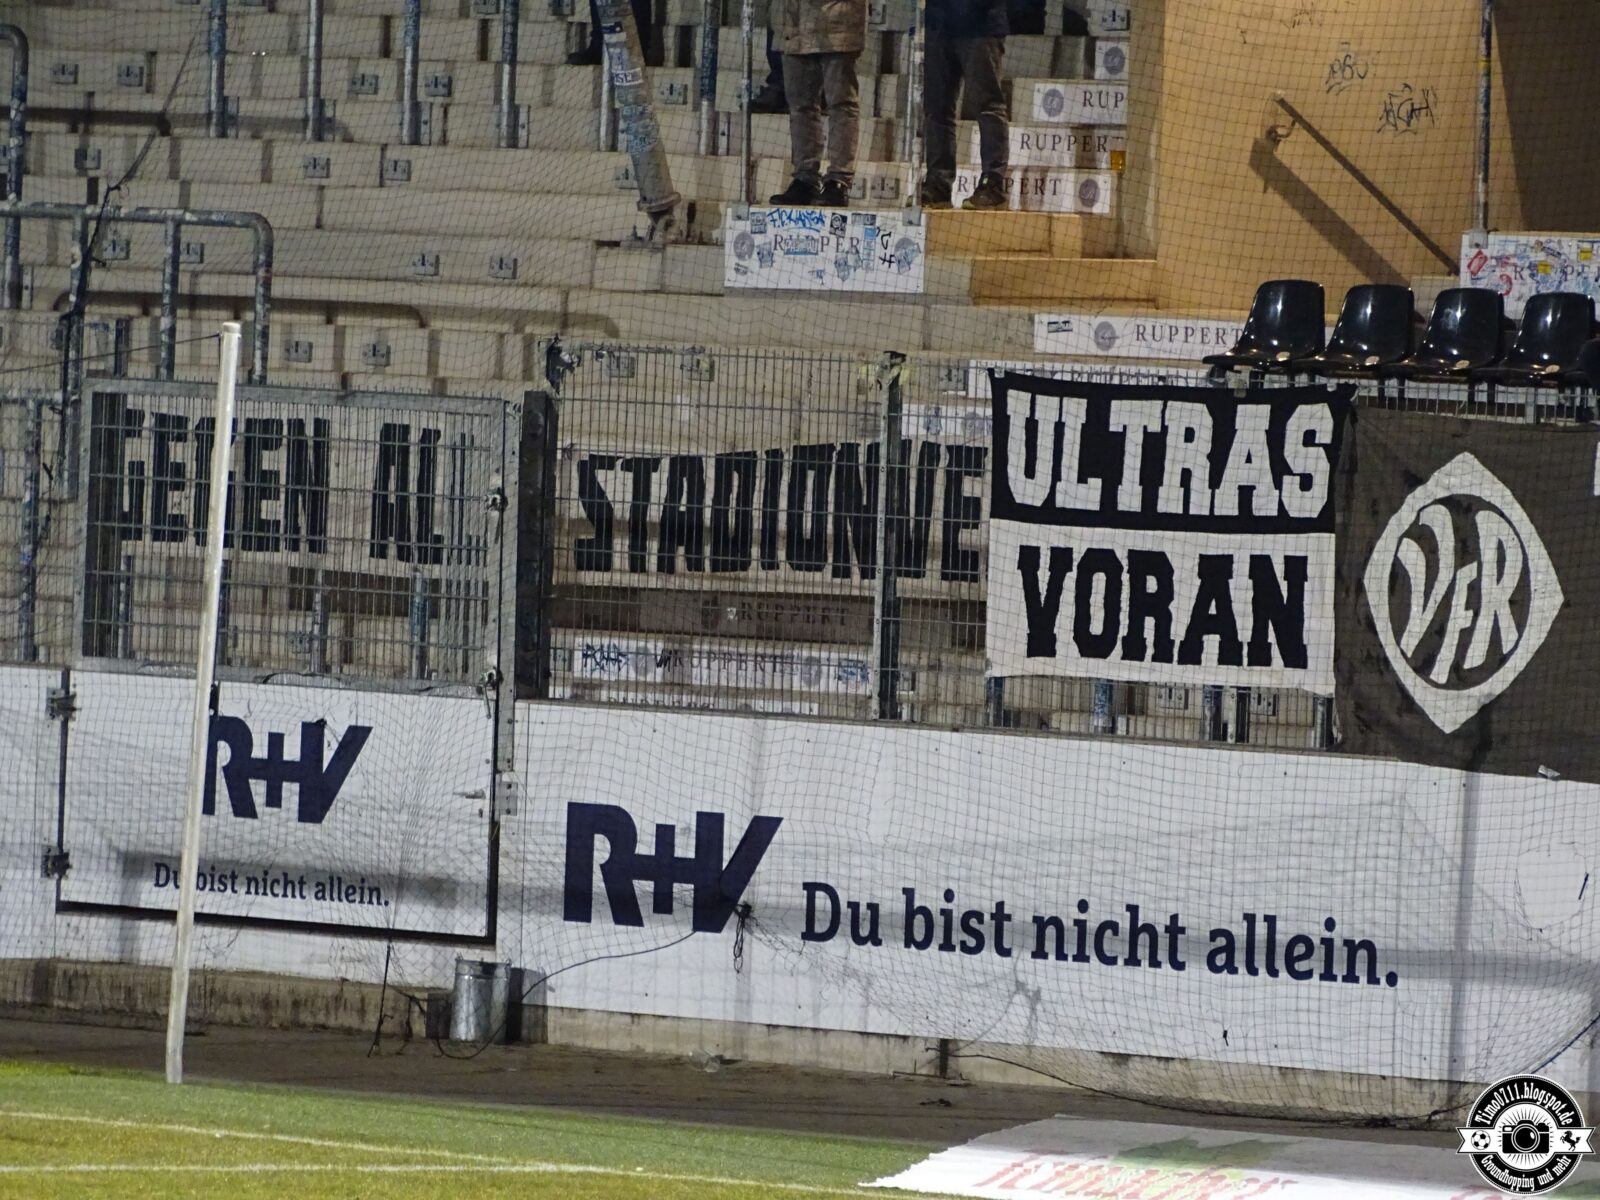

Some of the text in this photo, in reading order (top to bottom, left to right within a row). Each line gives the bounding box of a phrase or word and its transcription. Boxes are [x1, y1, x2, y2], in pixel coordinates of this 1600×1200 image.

[957, 175, 1062, 196] RPERT
[1006, 389, 1334, 519] ULTRAS
[1017, 545, 1308, 670] VORAN
[202, 715, 373, 824] R+V
[246, 869, 306, 899] nicht
[314, 874, 390, 907] allein.
[564, 801, 784, 934] R+V
[801, 881, 1399, 987] Du bist nicht allein.
